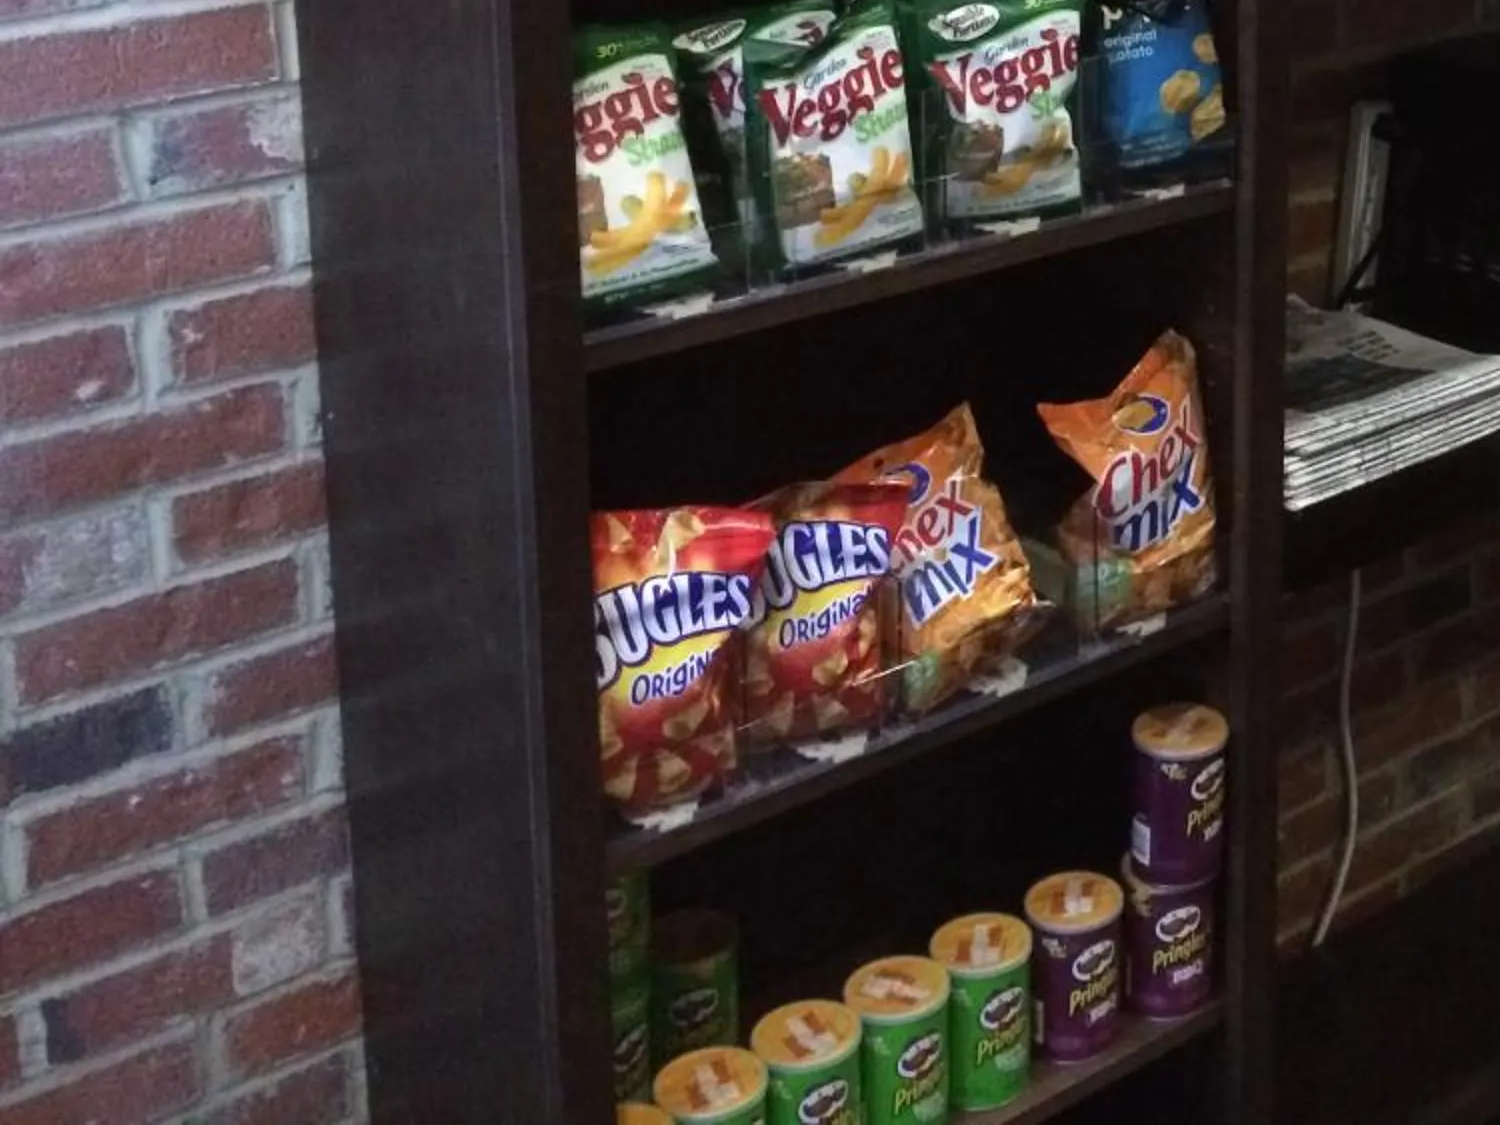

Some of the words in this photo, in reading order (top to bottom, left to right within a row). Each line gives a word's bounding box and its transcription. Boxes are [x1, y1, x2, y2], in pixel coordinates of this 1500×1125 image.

[757, 46, 907, 148] Veggie
[929, 28, 1081, 115] Veggie
[1096, 405, 1199, 520] Chex
